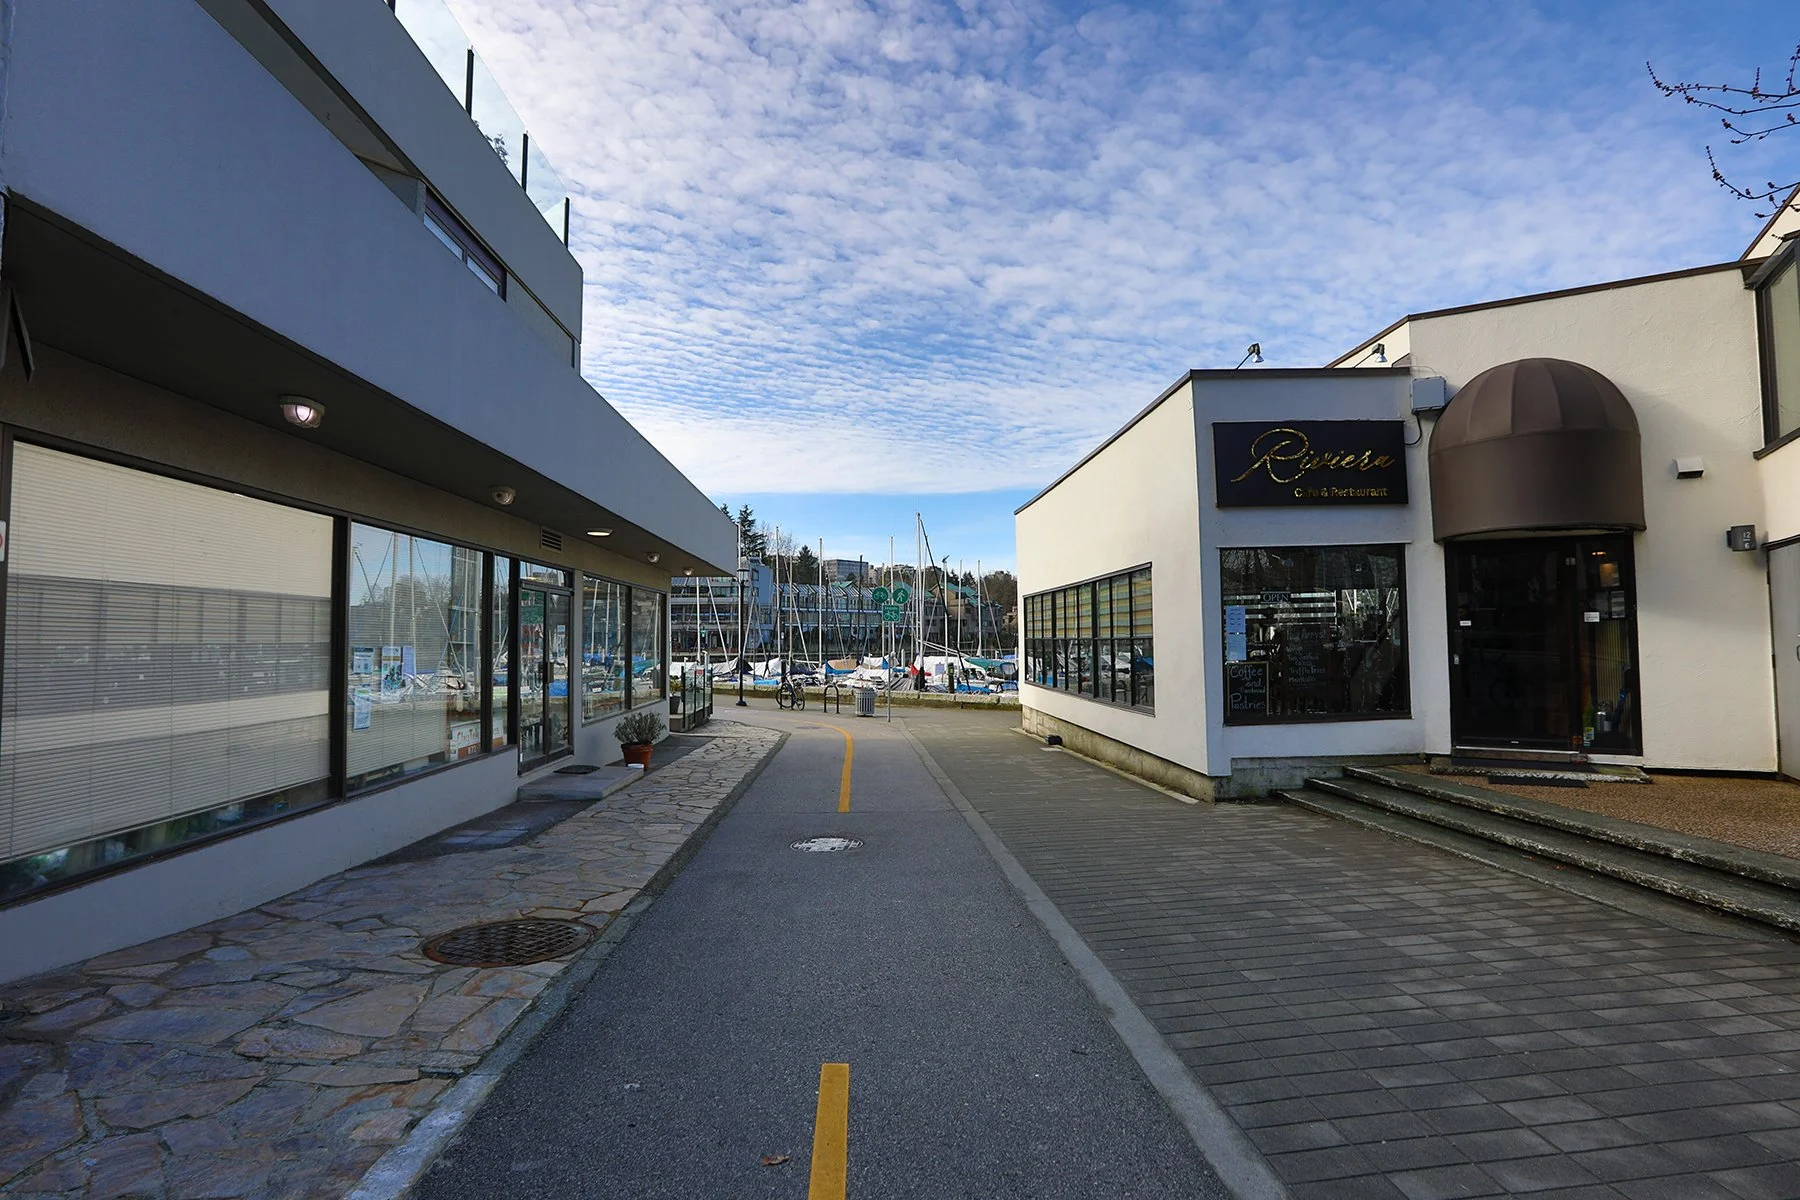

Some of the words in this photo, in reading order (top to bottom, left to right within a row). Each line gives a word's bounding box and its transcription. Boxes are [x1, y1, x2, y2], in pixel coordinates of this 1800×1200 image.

[1230, 428, 1396, 483] Riviera
[1320, 487, 1329, 497] &
[1331, 486, 1388, 497] Restaurant
[1262, 593, 1289, 601] OPEN
[1230, 664, 1264, 681] Coffee
[1244, 678, 1263, 687] and
[1230, 692, 1266, 710] Pastries
